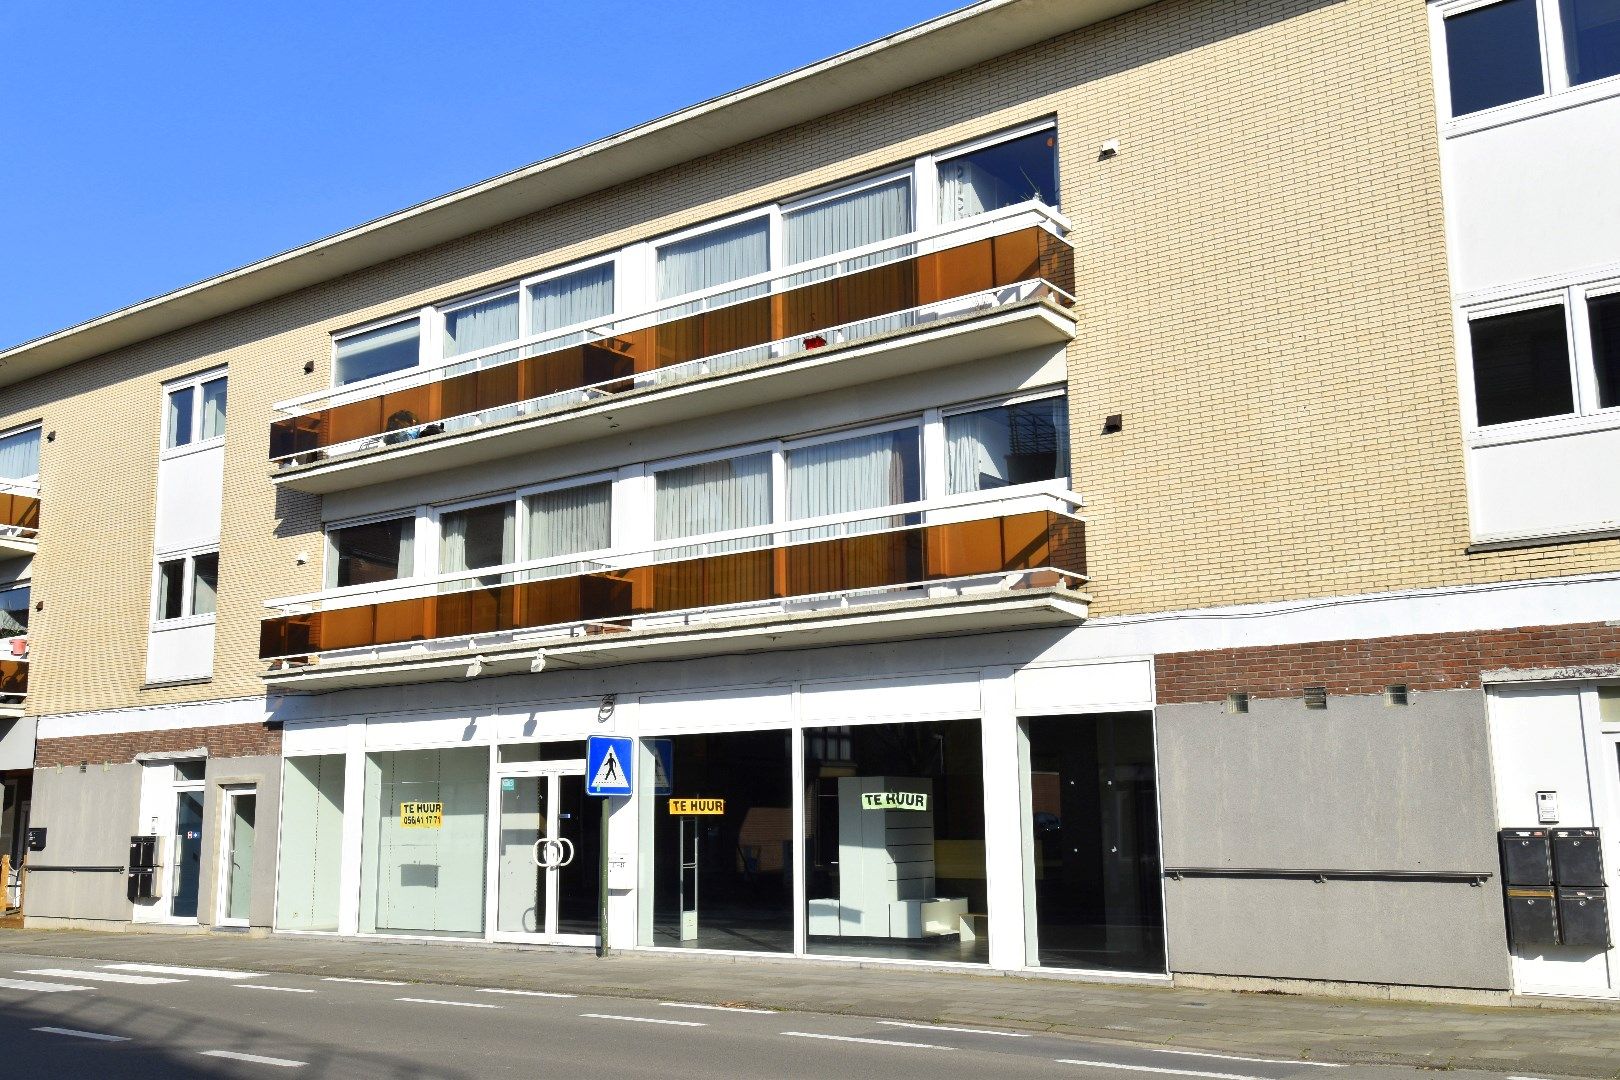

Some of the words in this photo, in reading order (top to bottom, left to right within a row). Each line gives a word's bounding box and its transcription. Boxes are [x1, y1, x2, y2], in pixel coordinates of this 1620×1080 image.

[865, 795, 882, 805] TE
[886, 793, 923, 806] HUUR
[404, 804, 414, 813] TE
[417, 804, 441, 813] HUUR
[673, 801, 686, 811] TE
[691, 801, 723, 811] HUUR
